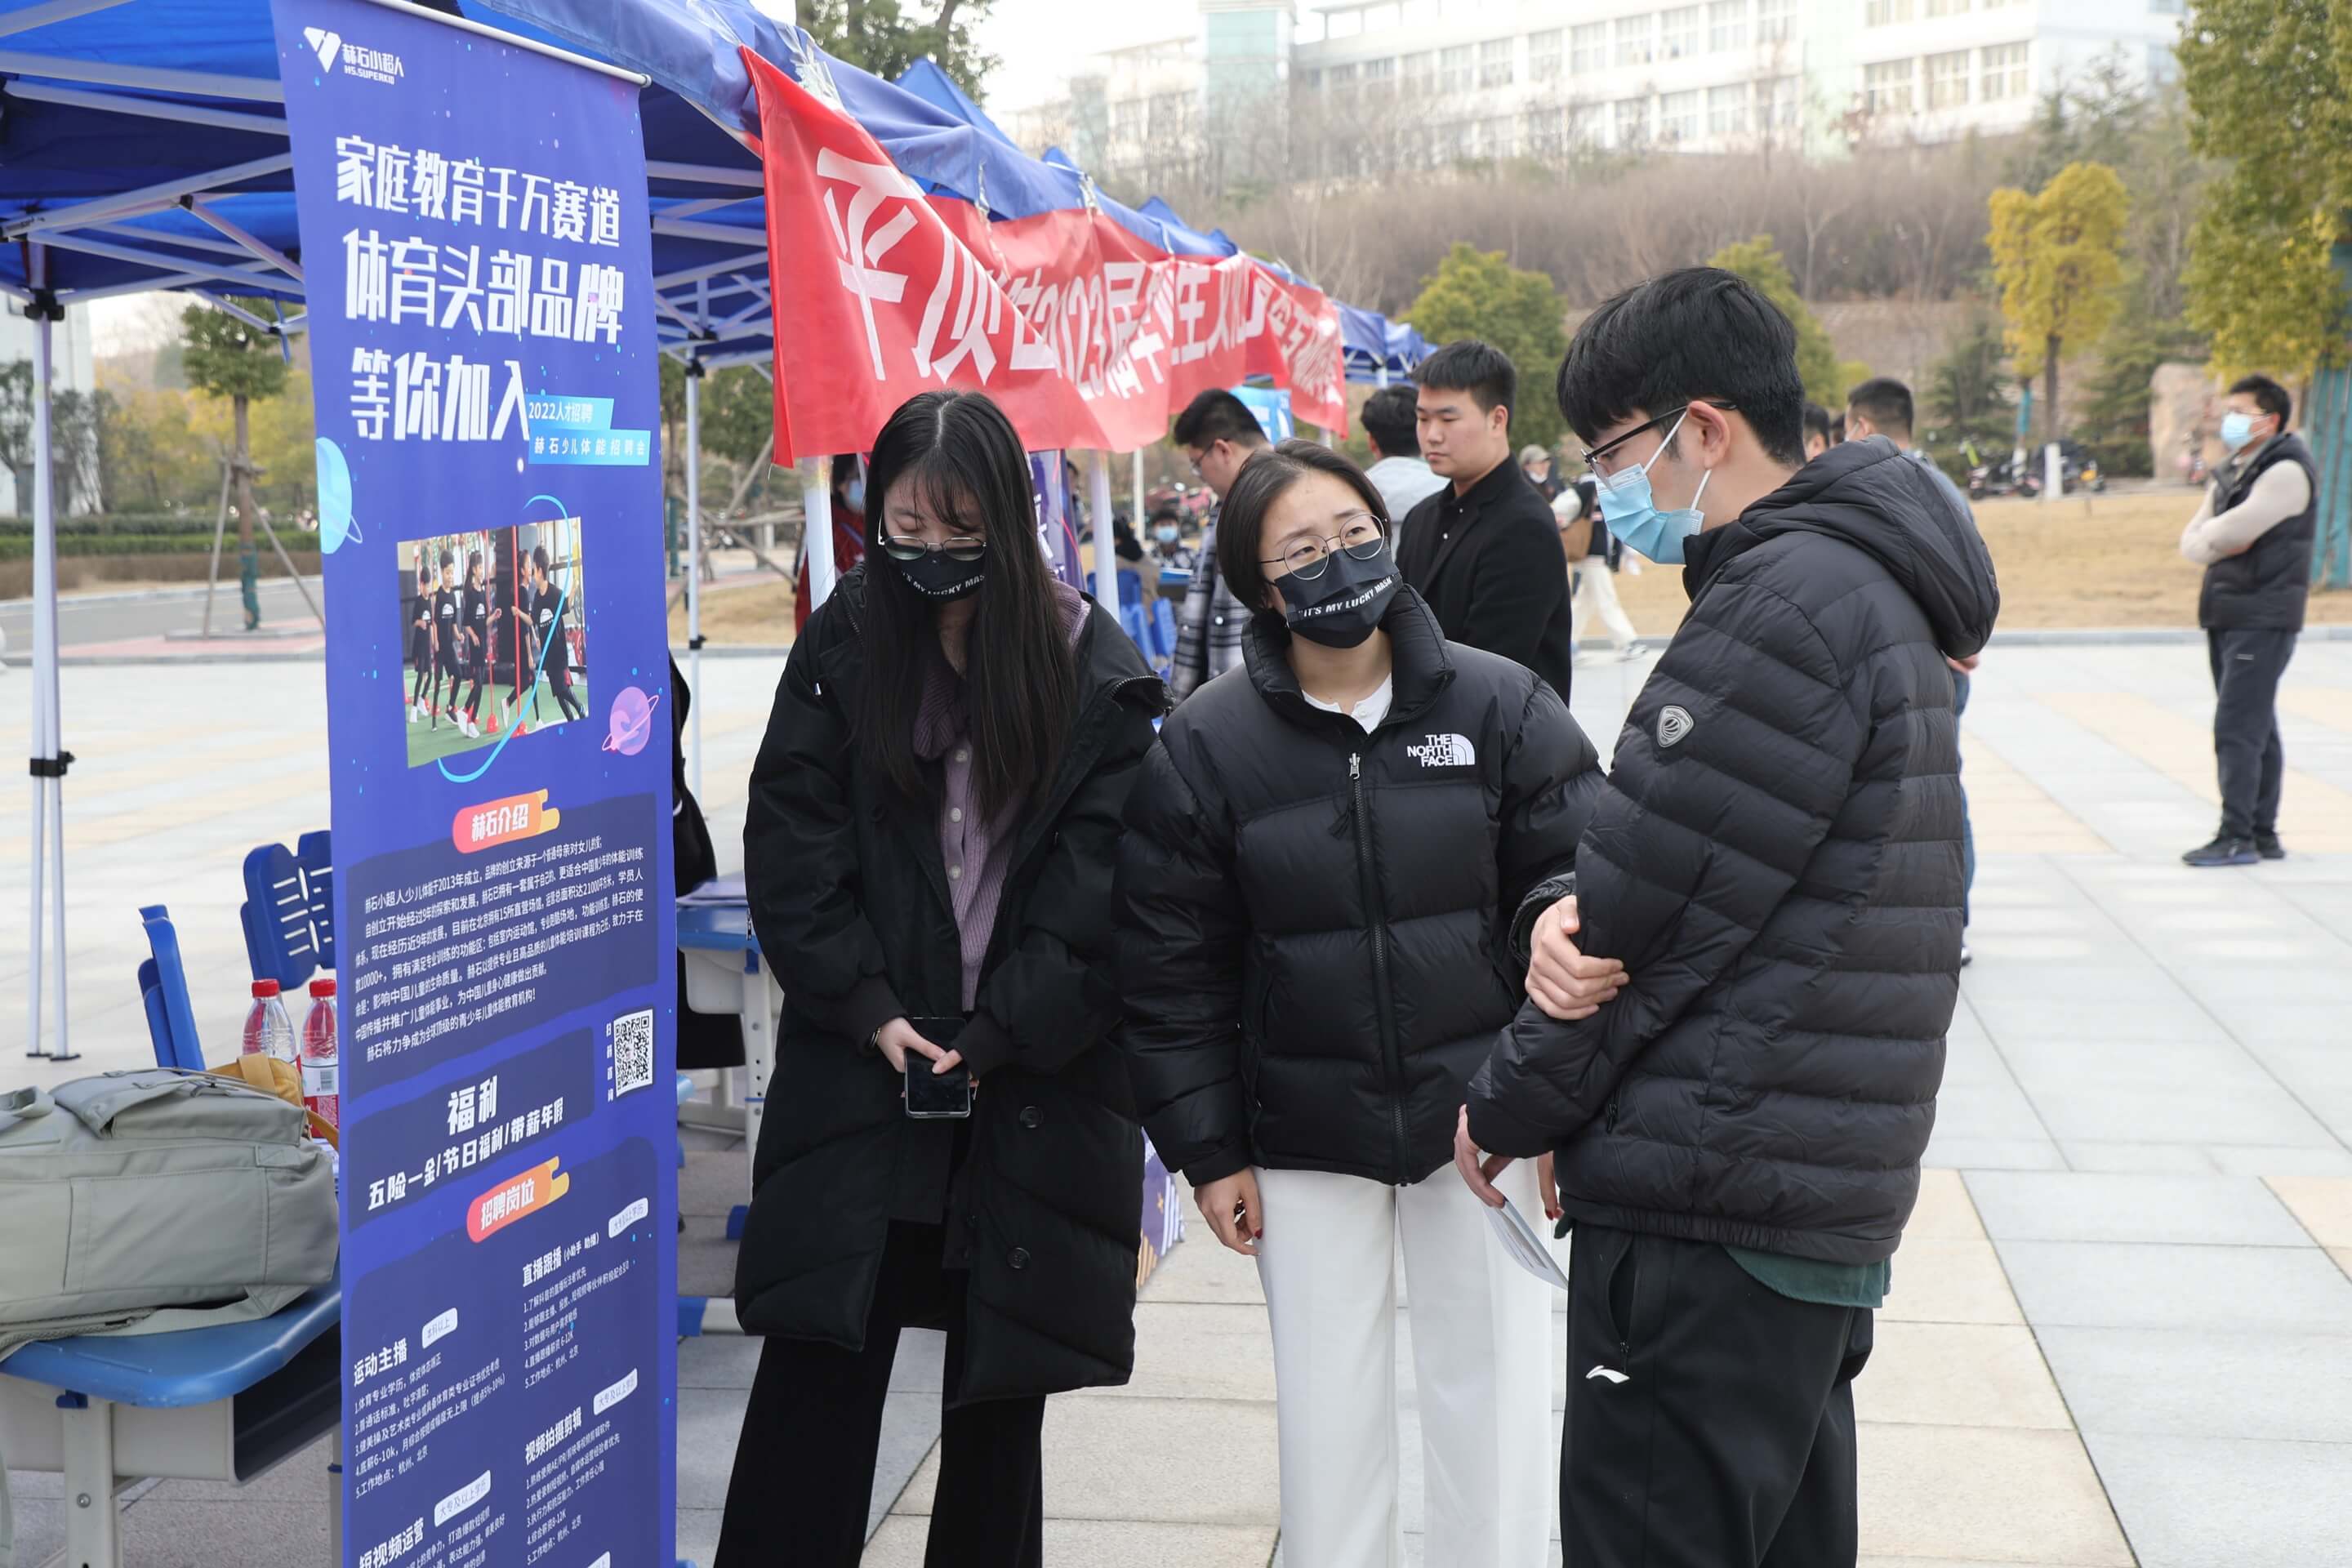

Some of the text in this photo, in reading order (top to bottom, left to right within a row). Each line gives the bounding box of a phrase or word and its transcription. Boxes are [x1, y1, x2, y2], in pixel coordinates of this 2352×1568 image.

[342, 43, 404, 78] 赫石小超人
[336, 135, 620, 247] 家庭教育千万赛道
[342, 228, 625, 344] 体育头部品牌
[350, 346, 530, 441] 等你加入
[528, 401, 594, 424] 2022人才招聘
[964, 574, 985, 588] MAS
[1325, 601, 1343, 613] MY
[1345, 587, 1374, 609] LUCKY
[1406, 744, 1453, 758] NORTH
[1421, 755, 1454, 767] FACE
[1425, 734, 1451, 746] THE
[471, 803, 529, 843] 赫石介绍
[447, 1075, 498, 1136] 福利
[368, 1097, 564, 1211] 五险一金/节日福利/带薪年假
[480, 1178, 536, 1231] 招聘岗位
[523, 1245, 562, 1288] 直播跟播
[354, 1337, 408, 1388] 运动主播
[525, 1405, 581, 1466] 视频拍摄剪辑
